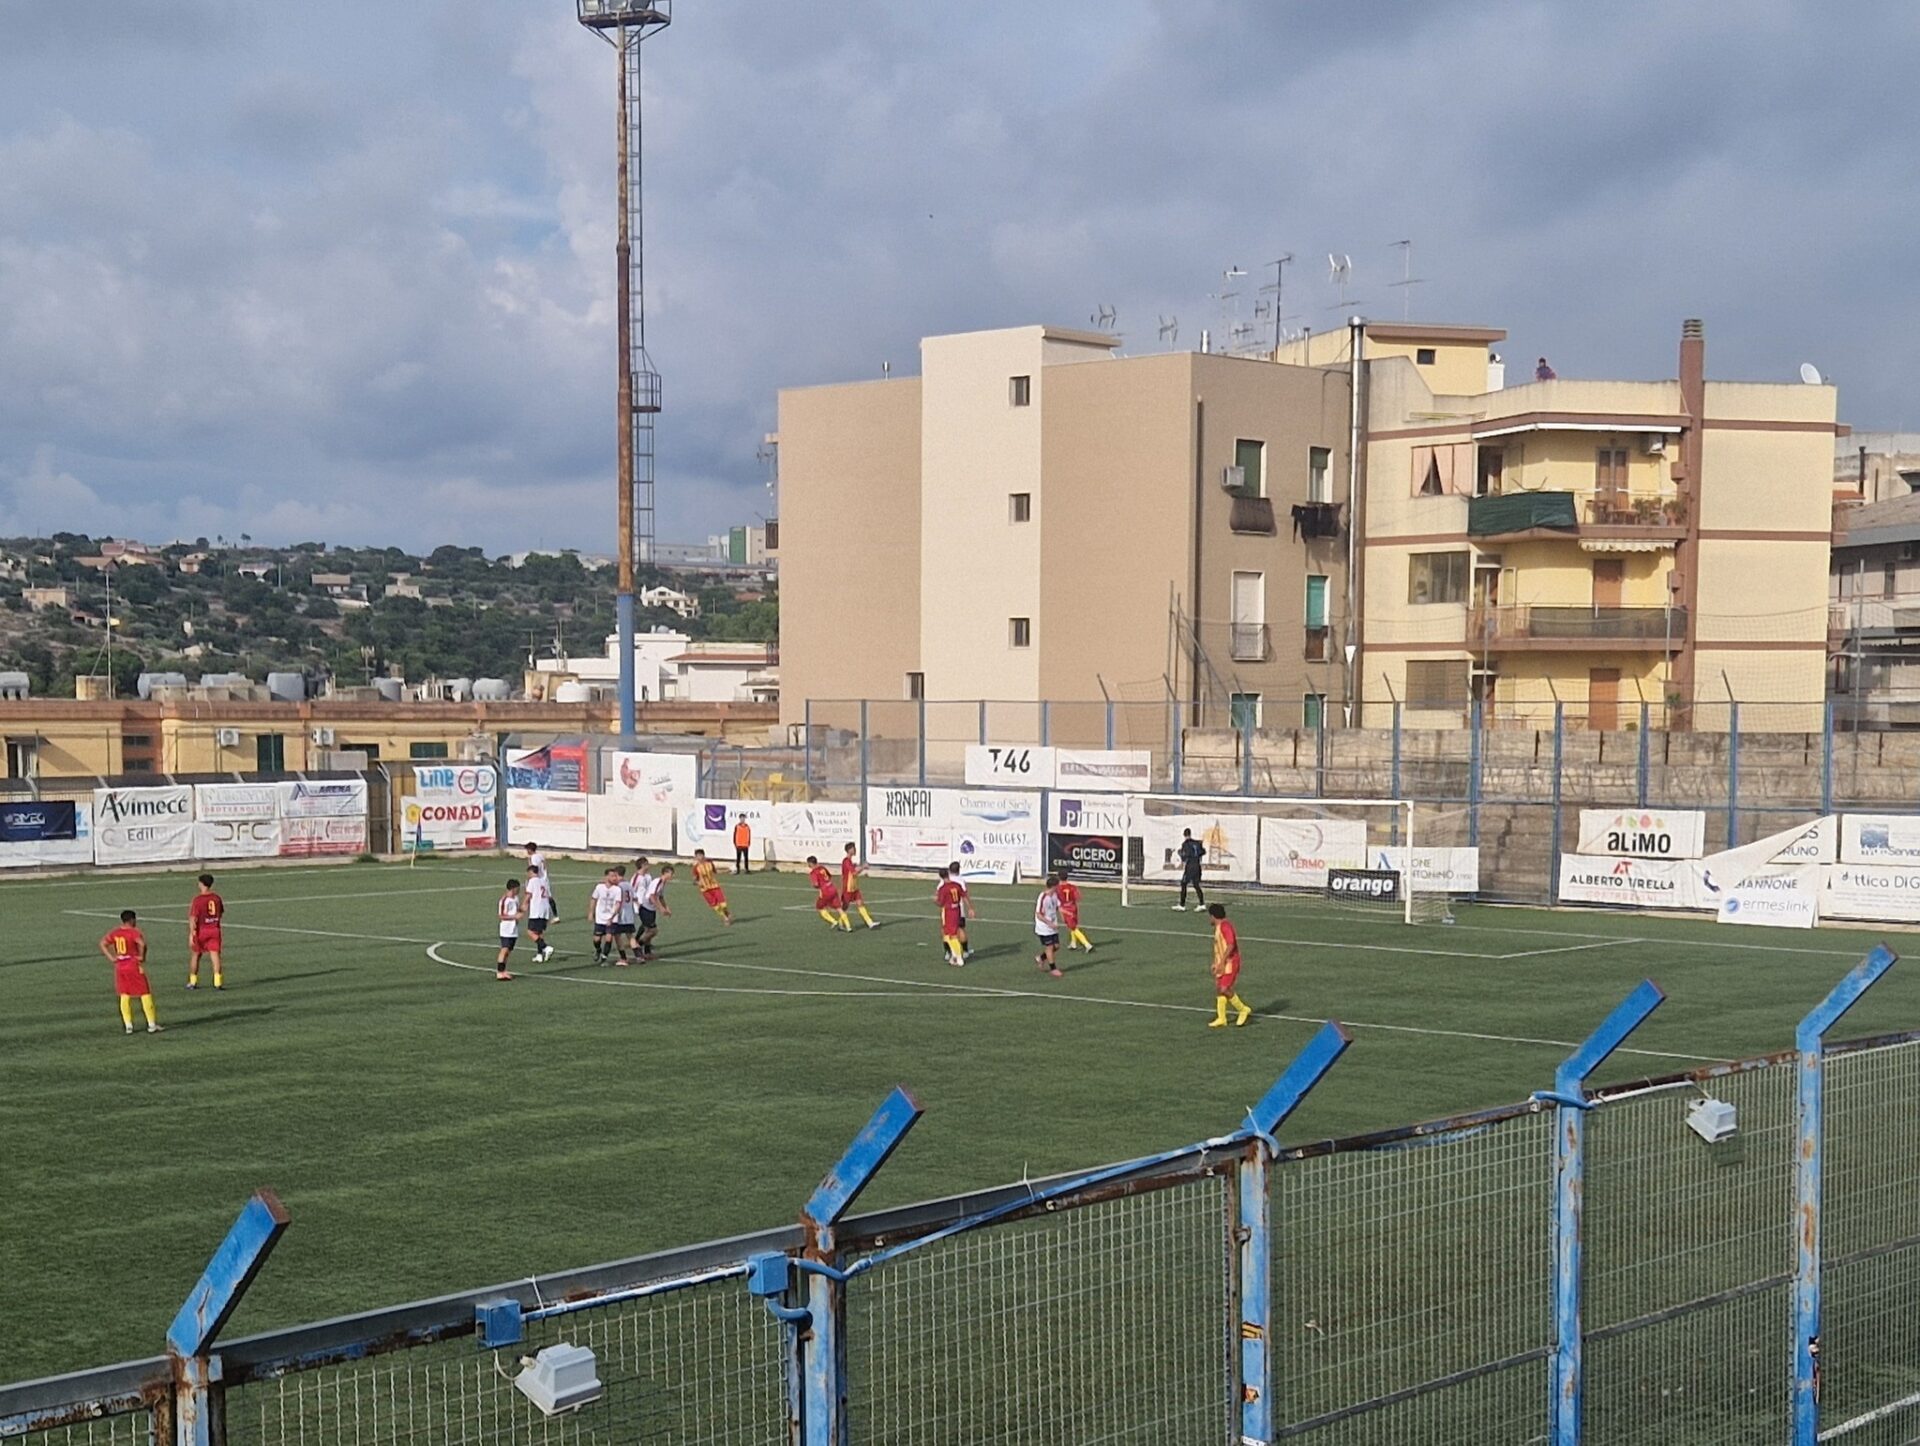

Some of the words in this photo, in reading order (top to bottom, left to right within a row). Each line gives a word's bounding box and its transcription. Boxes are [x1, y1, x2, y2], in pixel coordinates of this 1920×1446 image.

[996, 799, 1006, 809] of
[422, 805, 482, 821] CONAD
[1072, 847, 1116, 862] CICERO
[1782, 846, 1819, 857] RUNO
[1082, 860, 1136, 871] ROTTAMAZINE
[1401, 858, 1431, 868] LONE
[1332, 875, 1393, 896] orango
[1569, 875, 1623, 887] ALBERTO
[1743, 899, 1809, 913] ermeslink
[113, 935, 127, 955] 10
